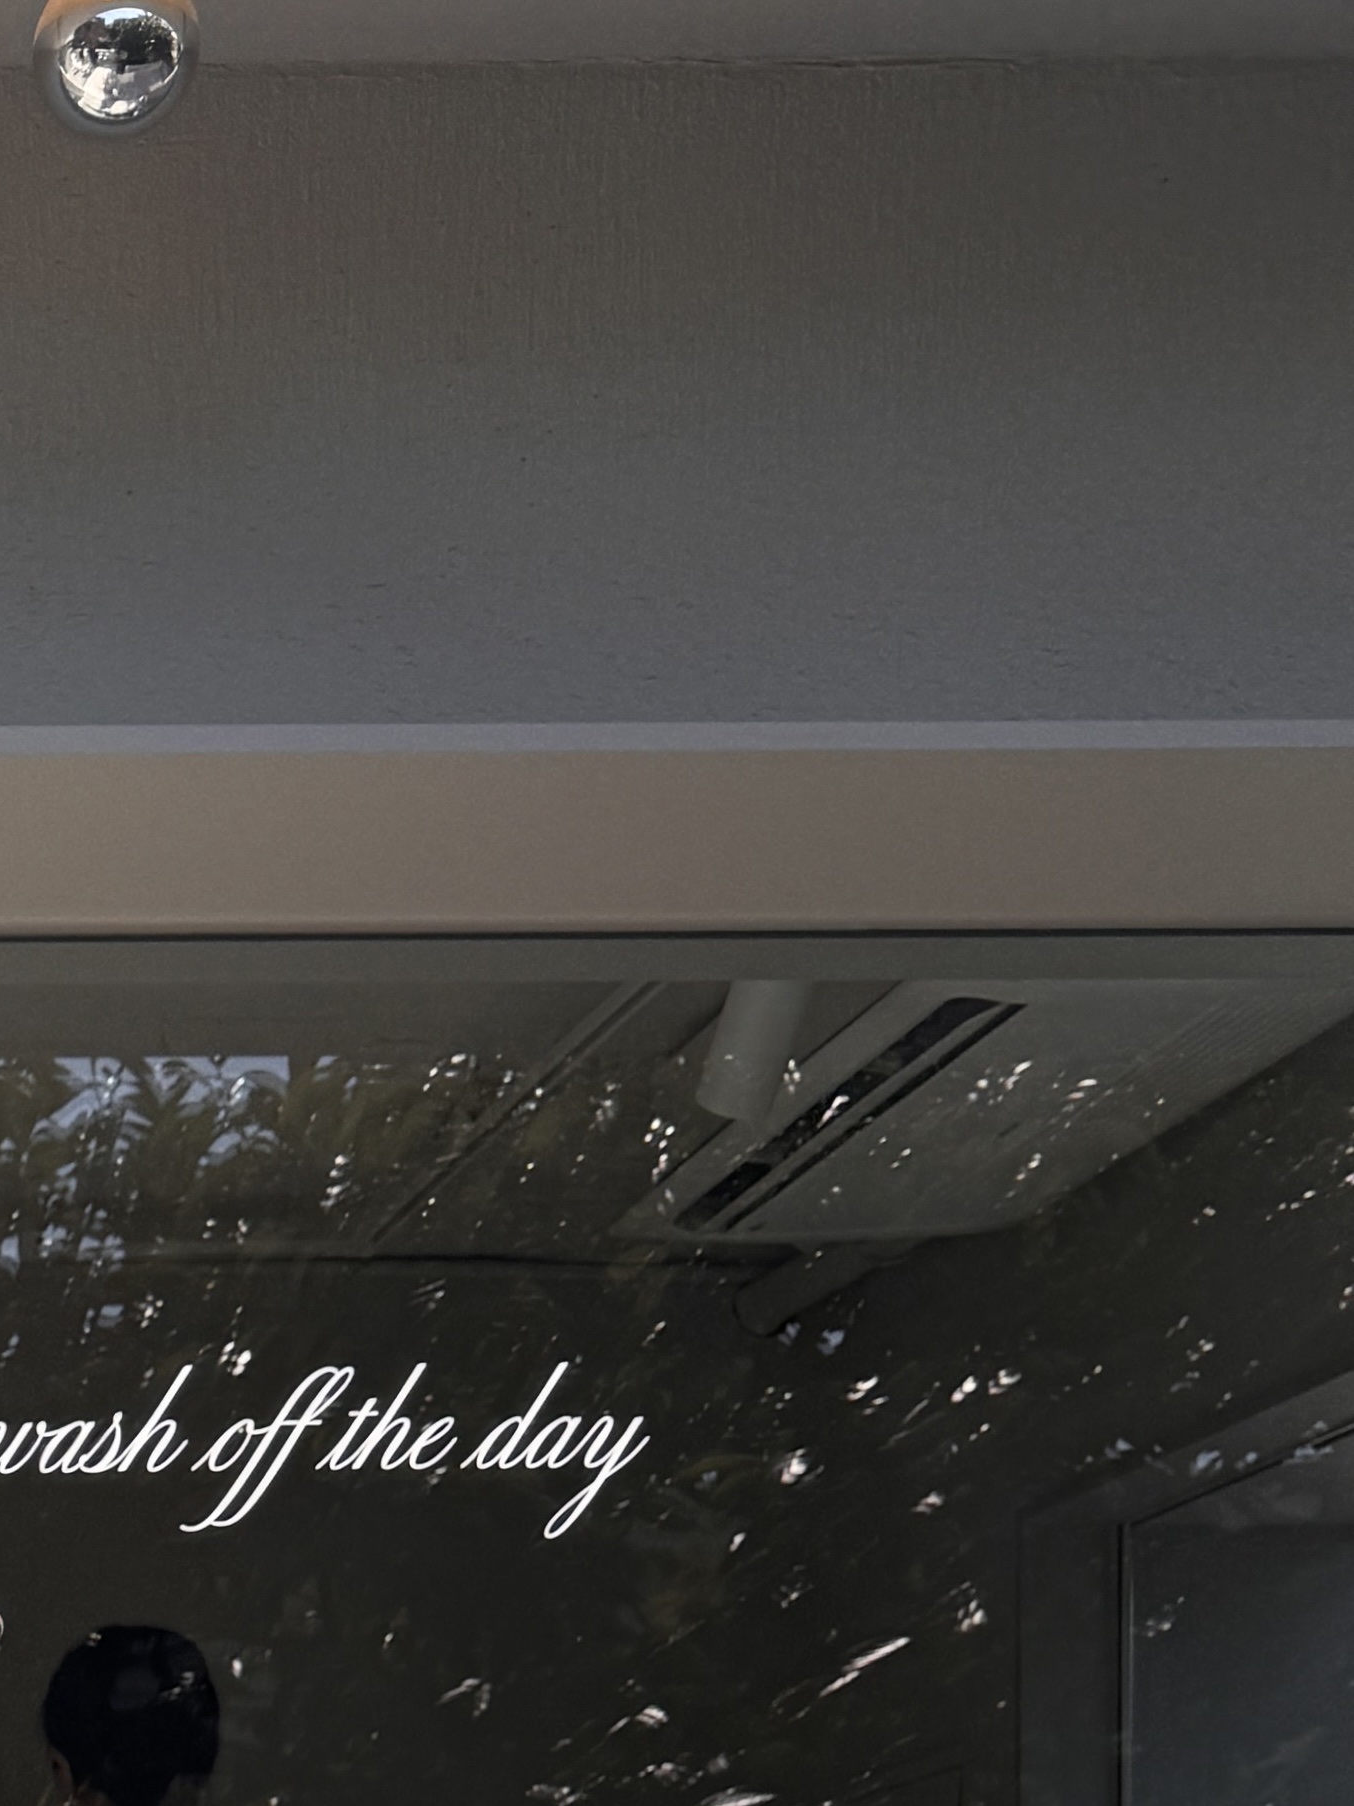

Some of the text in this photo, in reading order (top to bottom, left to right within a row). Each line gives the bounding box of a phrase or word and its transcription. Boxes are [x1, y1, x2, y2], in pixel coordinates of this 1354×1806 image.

[179, 1365, 355, 1533] off
[314, 1362, 458, 1472] the
[459, 1361, 651, 1540] day
